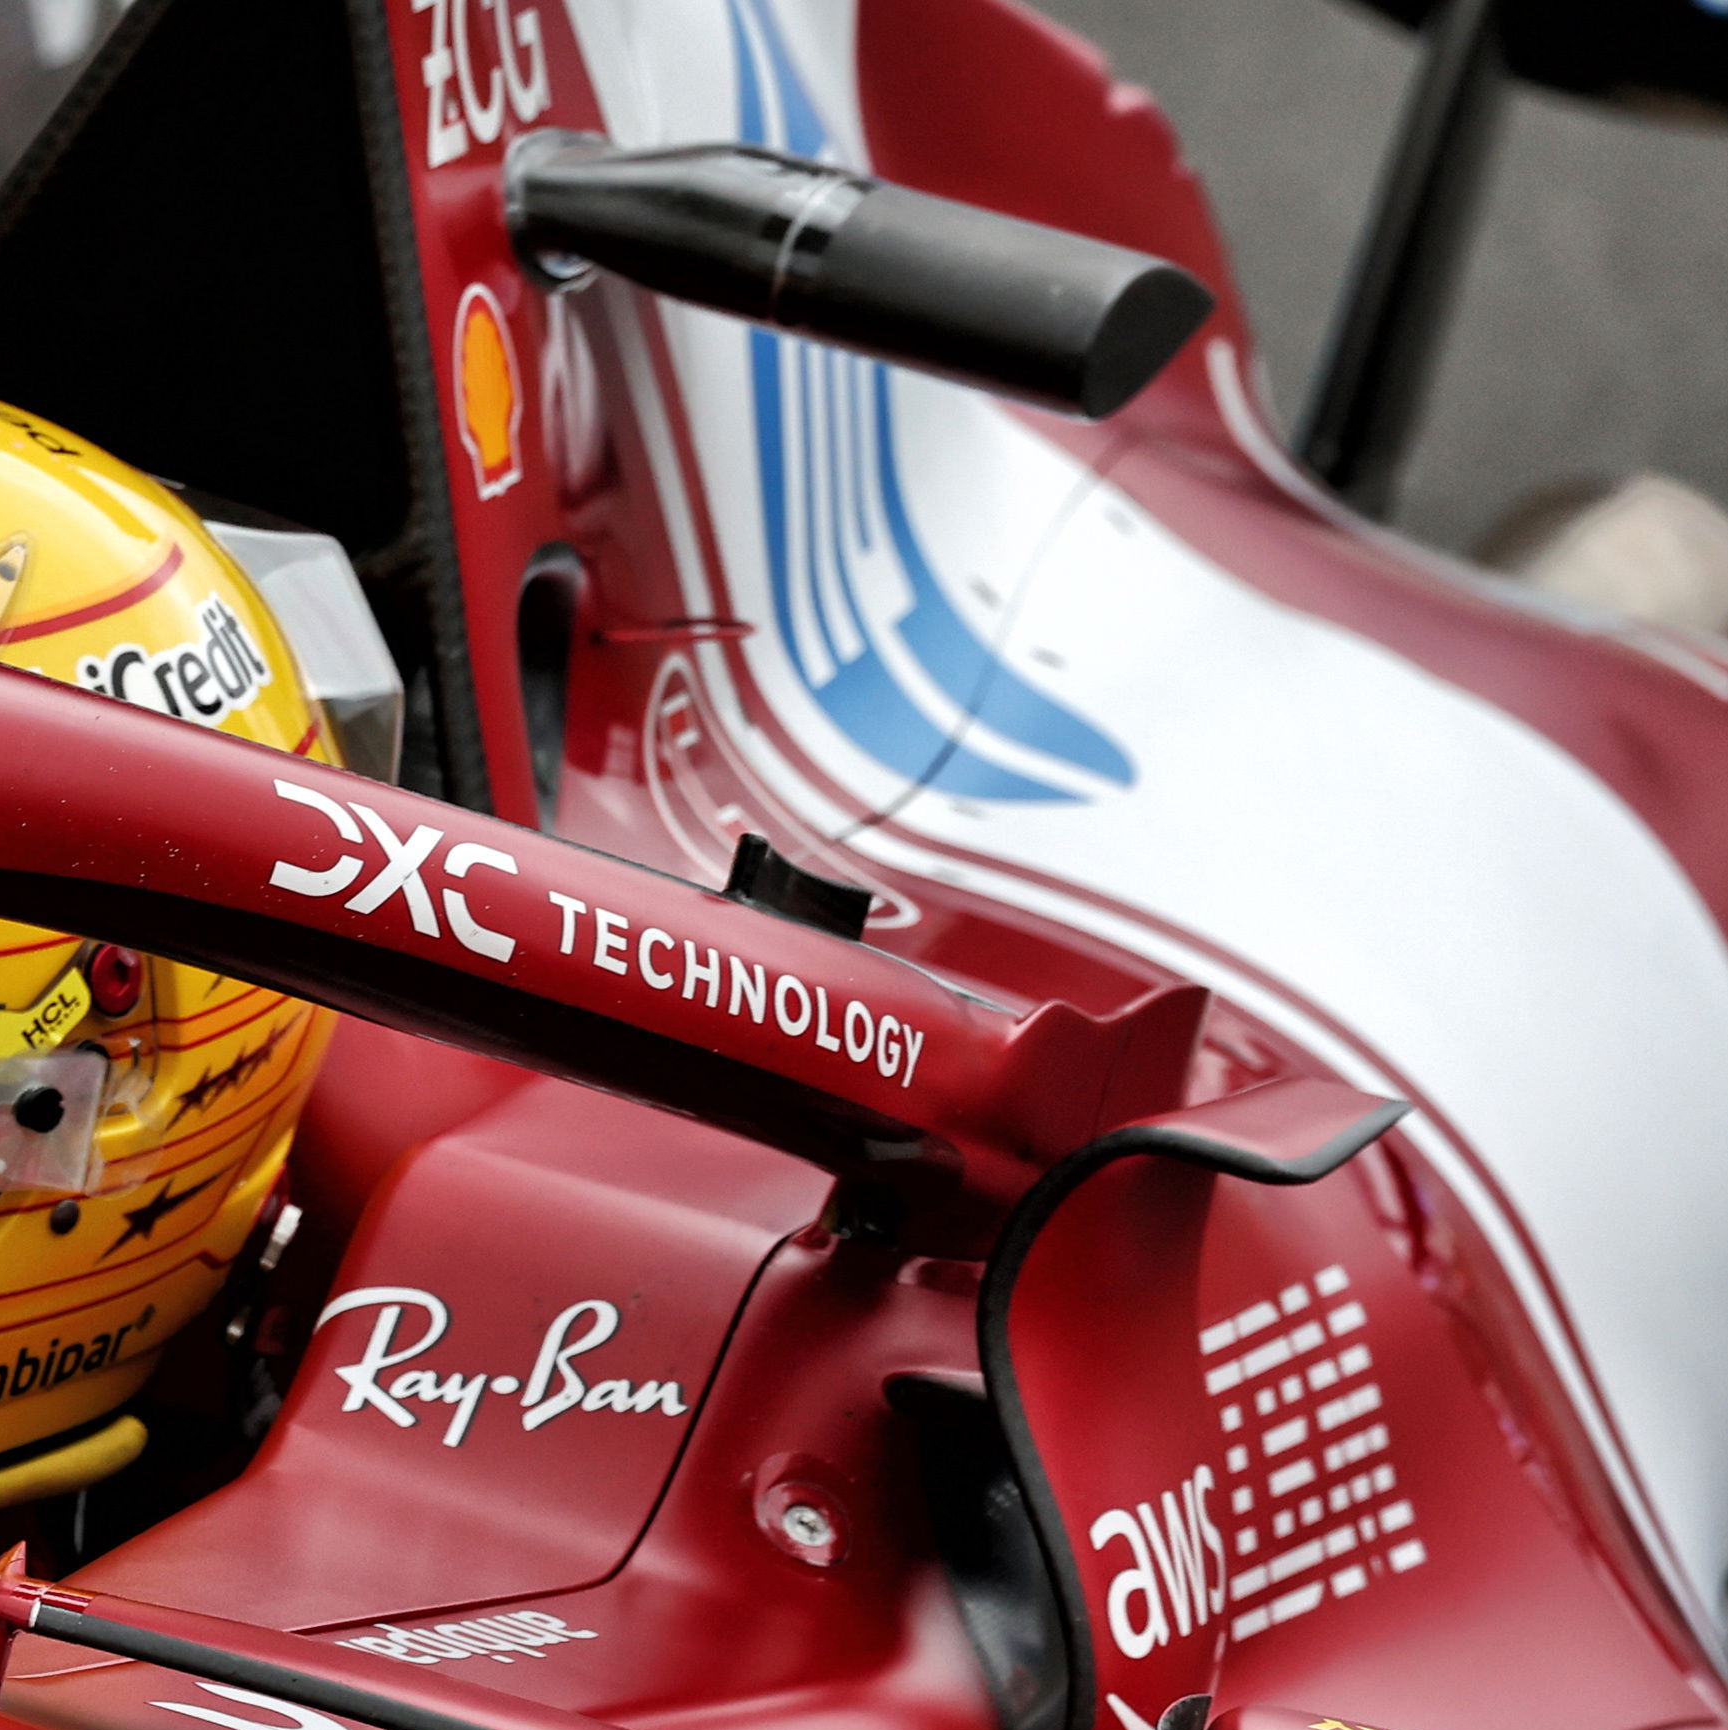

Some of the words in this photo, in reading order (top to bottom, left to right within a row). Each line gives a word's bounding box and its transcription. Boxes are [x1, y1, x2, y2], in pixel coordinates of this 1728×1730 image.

[85, 598, 267, 718] Credit
[268, 778, 518, 964] DXC
[548, 889, 925, 1089] TECHNOLOGY
[21, 993, 78, 1050] HCL
[1088, 1464, 1228, 1662] aws
